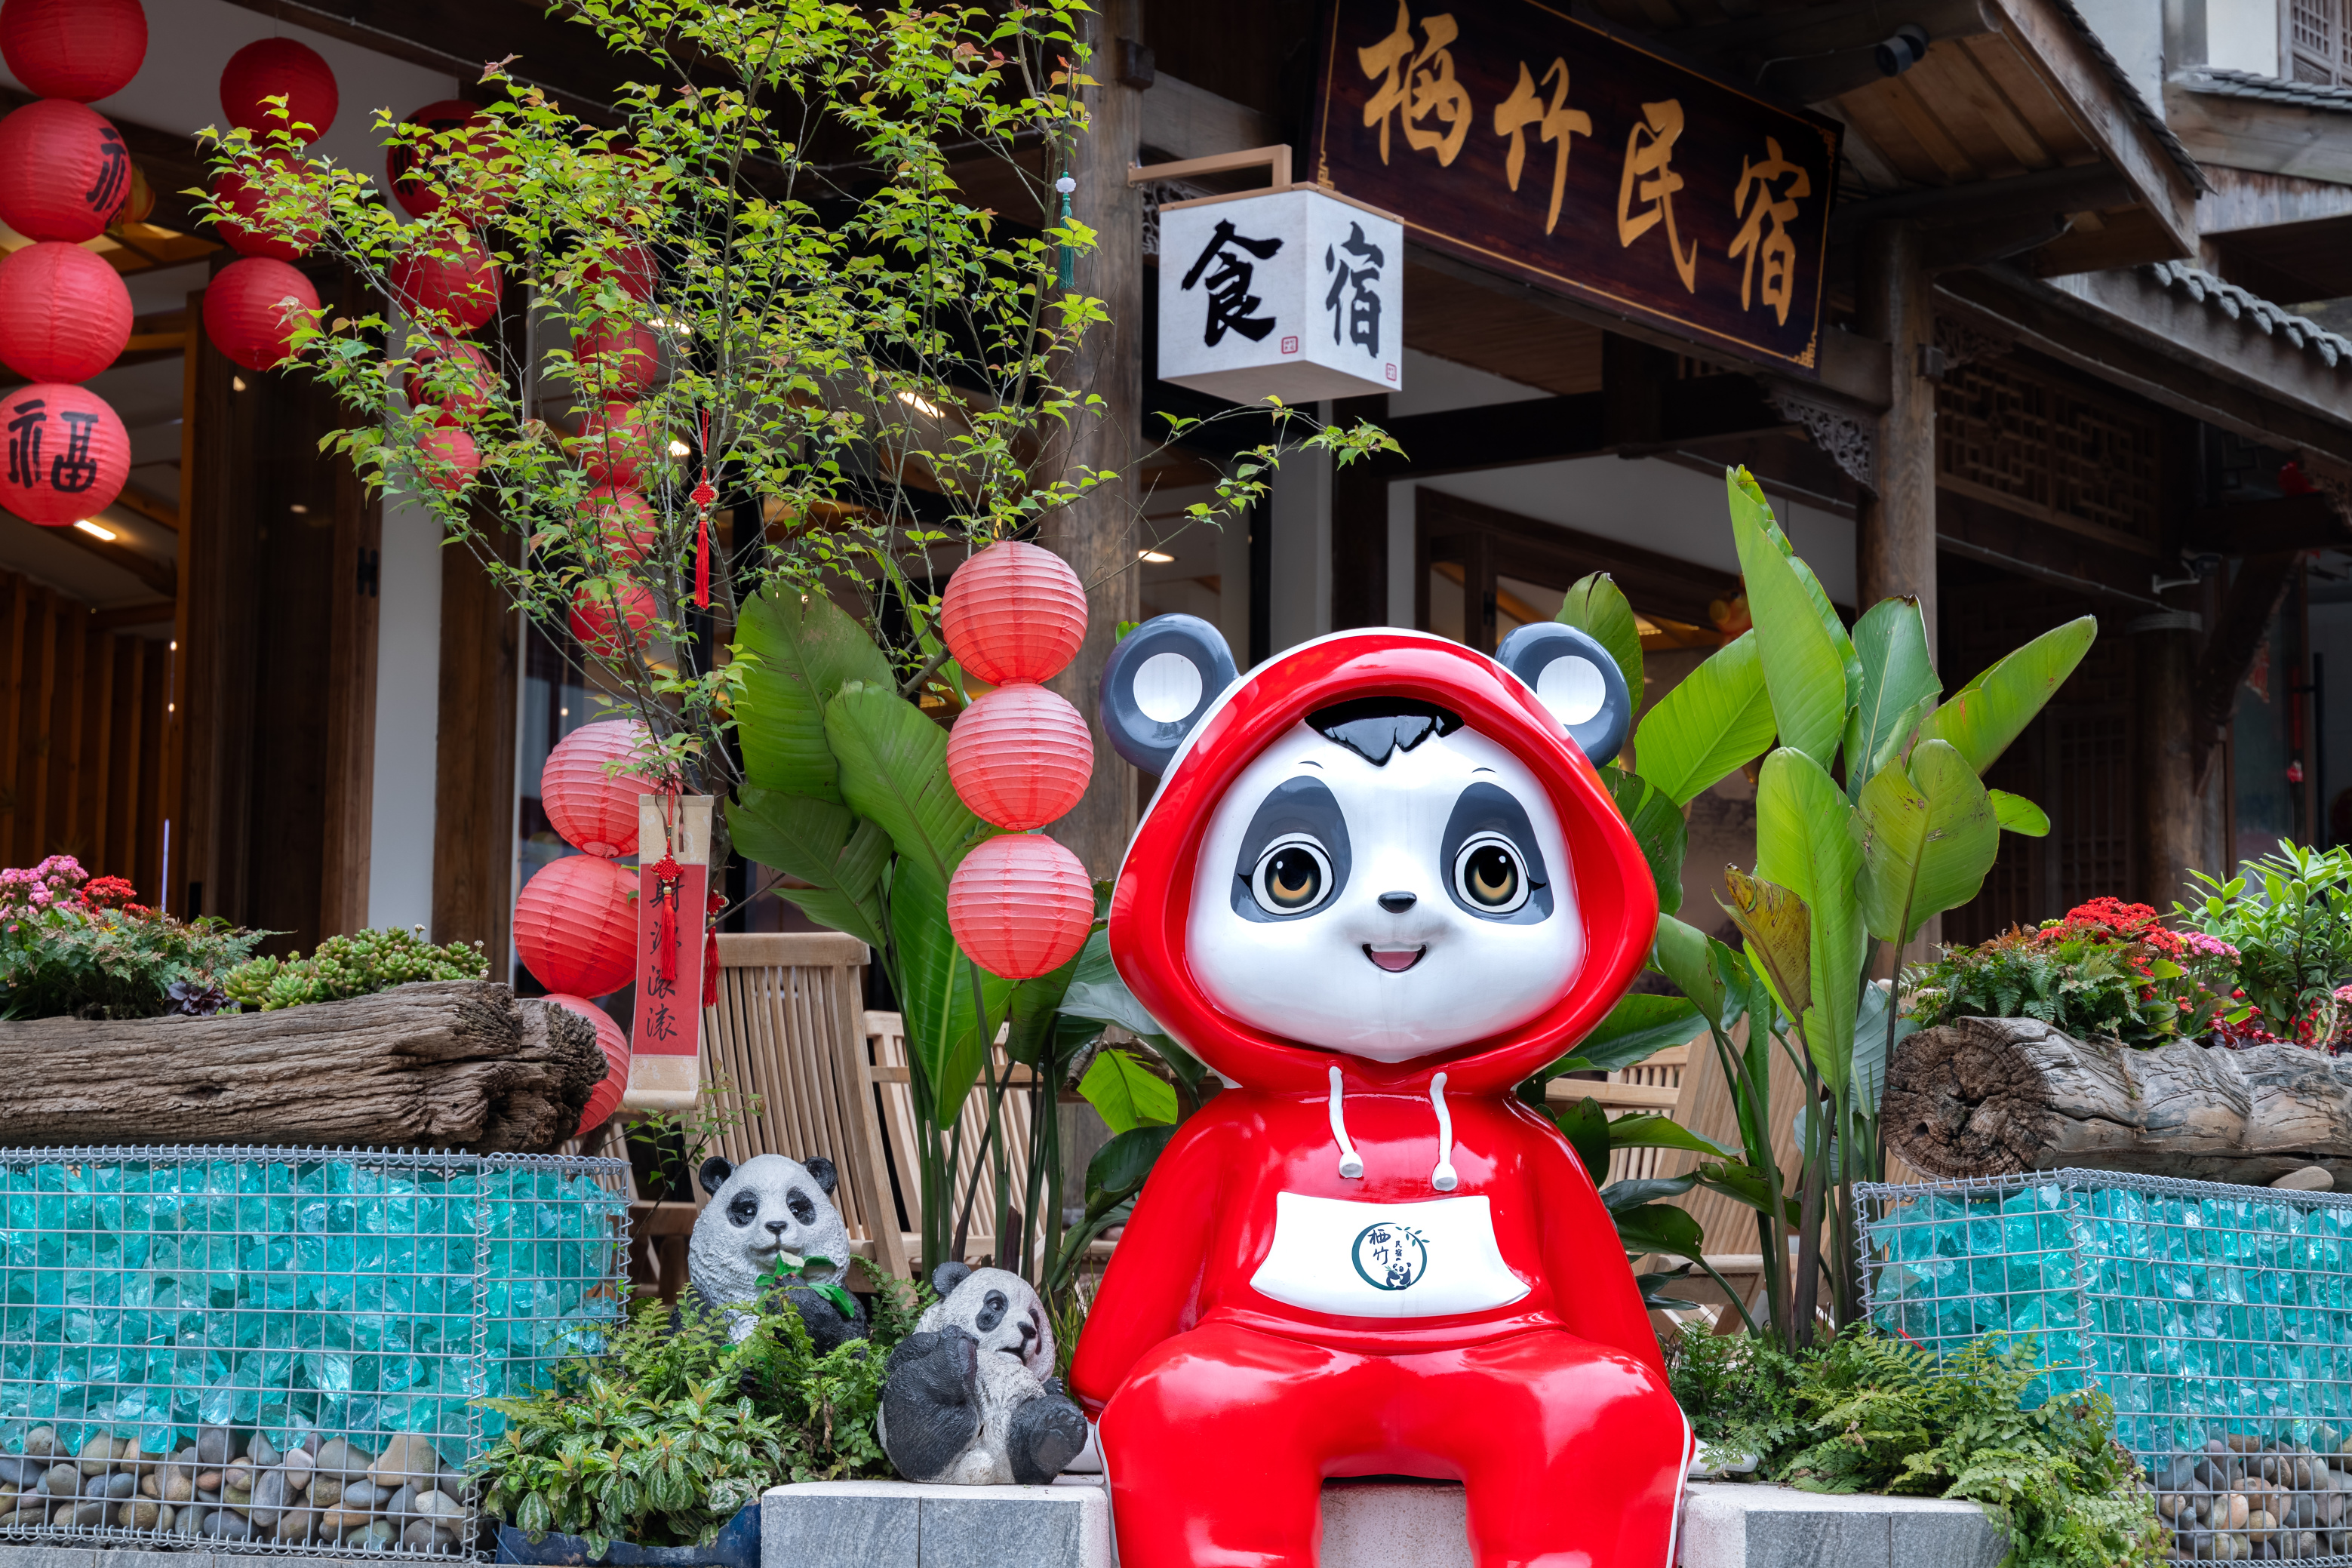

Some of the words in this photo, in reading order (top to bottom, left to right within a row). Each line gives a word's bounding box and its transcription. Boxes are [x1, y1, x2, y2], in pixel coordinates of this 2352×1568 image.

[1358, 0, 1811, 327] 栖竹民宿
[1180, 218, 1284, 347] 食
[1325, 220, 1385, 358] 宿
[8, 398, 99, 493] 福
[1367, 1228, 1391, 1265] 栖竹
[1394, 1241, 1403, 1257] 民宿
